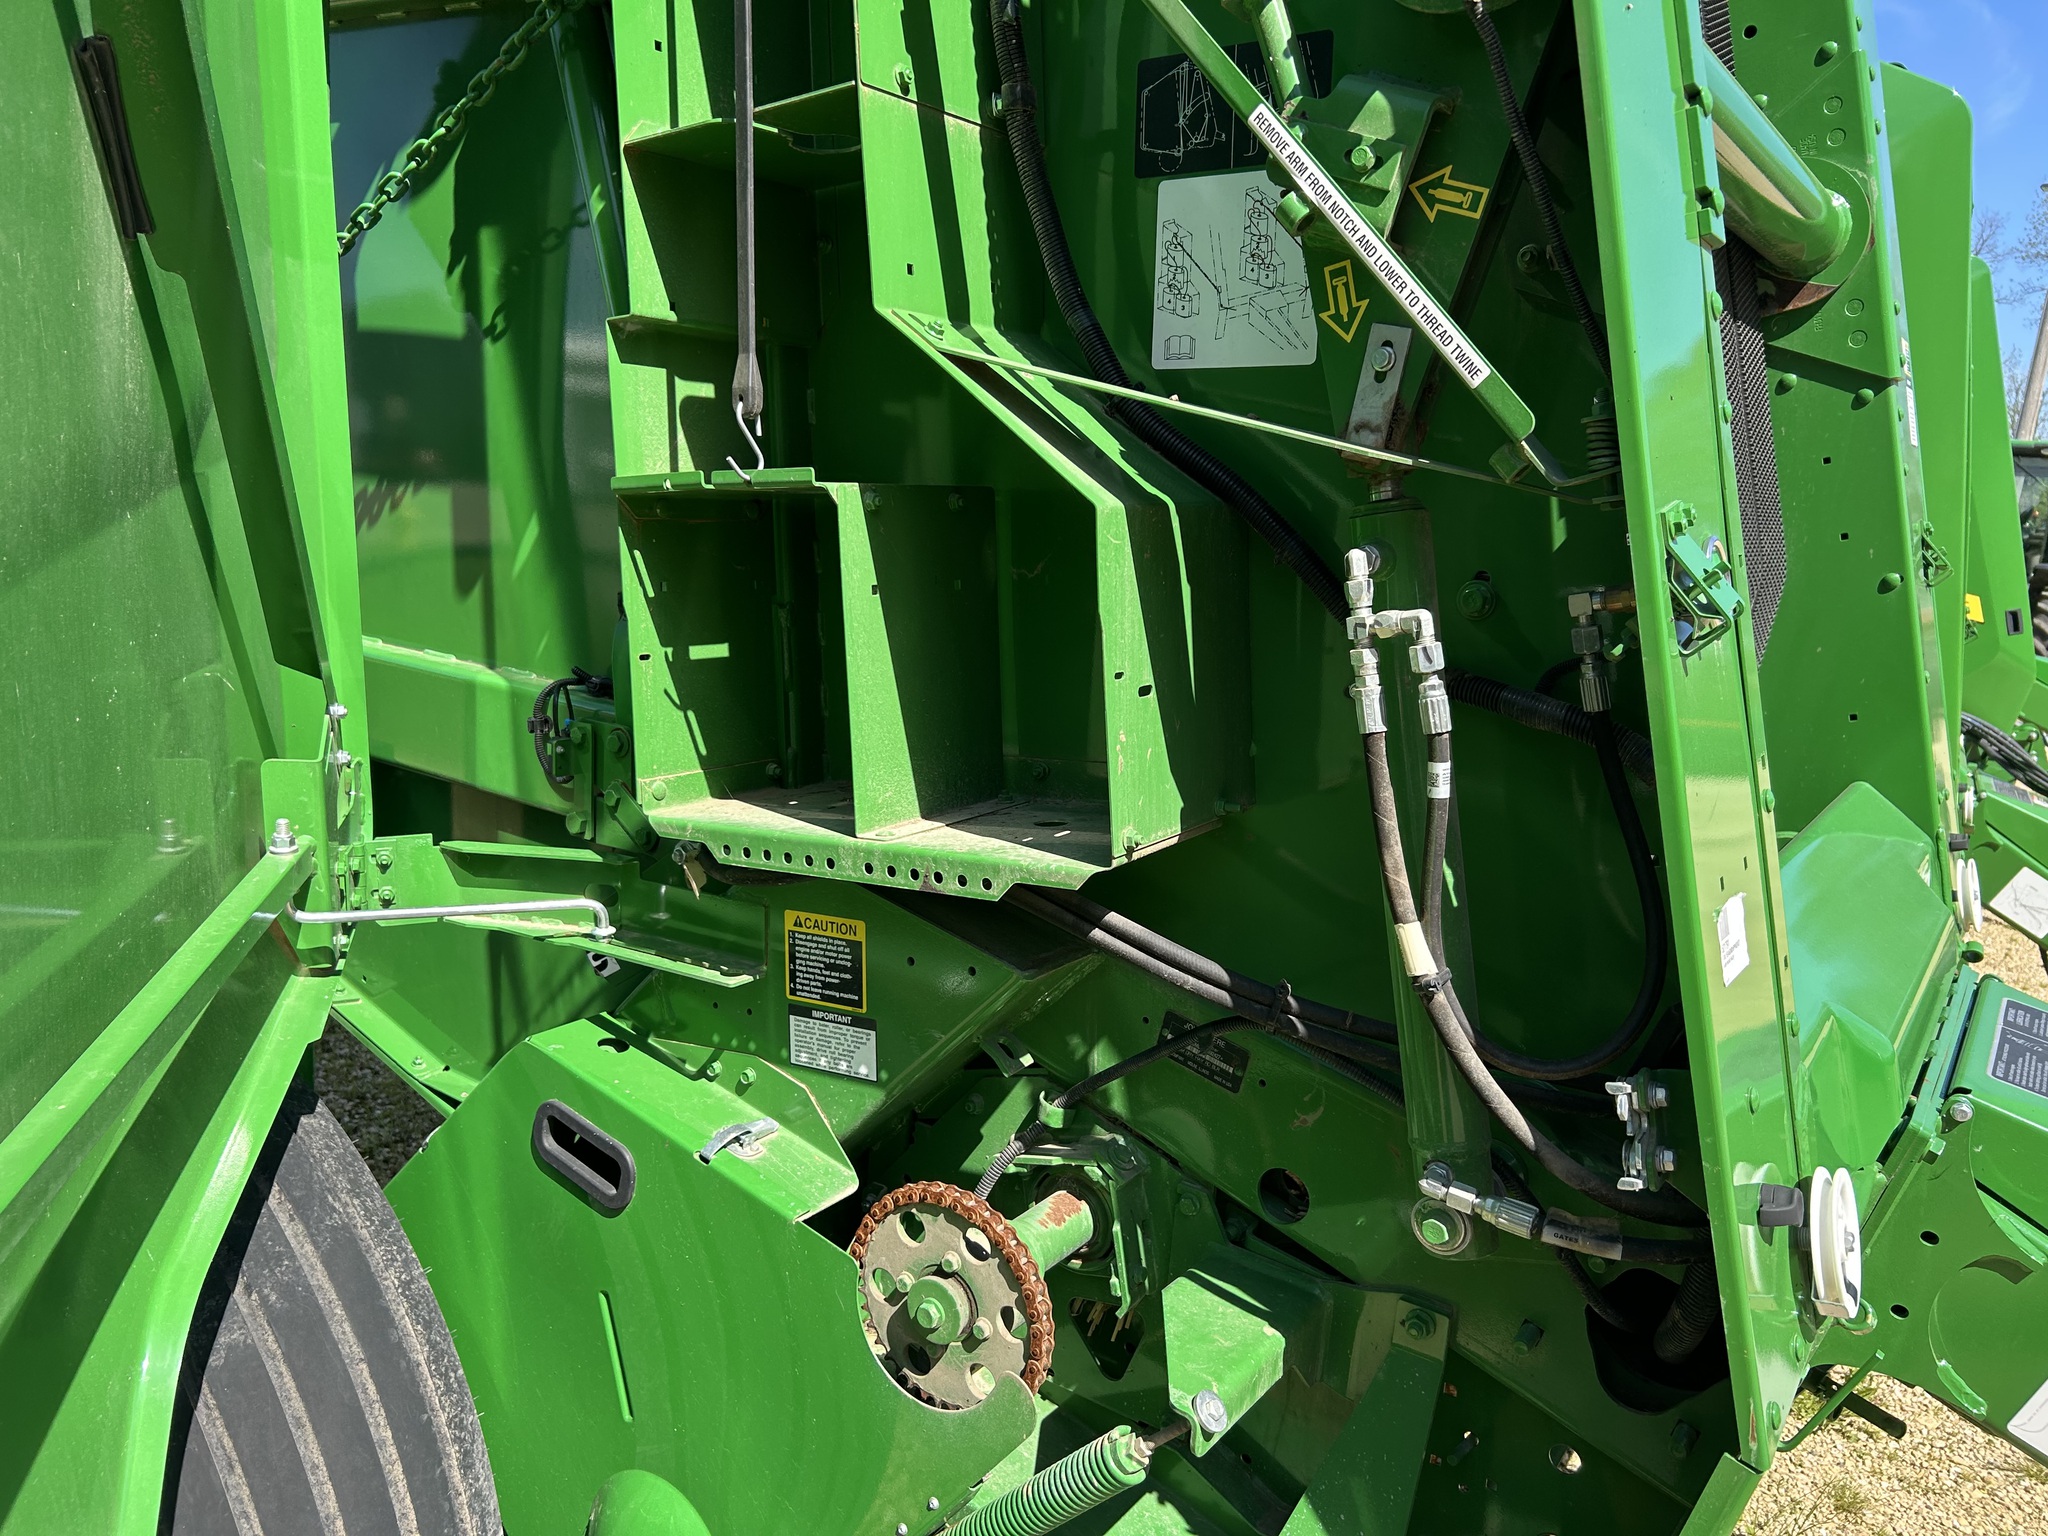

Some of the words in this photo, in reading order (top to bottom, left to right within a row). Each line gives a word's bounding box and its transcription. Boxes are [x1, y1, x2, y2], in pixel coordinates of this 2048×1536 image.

[1254, 112, 1290, 155] REMOVE
[1285, 151, 1308, 177] ARM
[1304, 172, 1332, 204] FROM
[1328, 201, 1360, 237] NOTCH
[1355, 234, 1377, 258] AND
[1374, 254, 1407, 294] LOWER
[1405, 289, 1419, 307] TO
[1417, 304, 1453, 347] THREAD
[1451, 344, 1482, 381] TWINE
[804, 917, 856, 936] CAUTION
[812, 1010, 852, 1024] IMPORTANT
[1554, 1232, 1578, 1243] GATES
